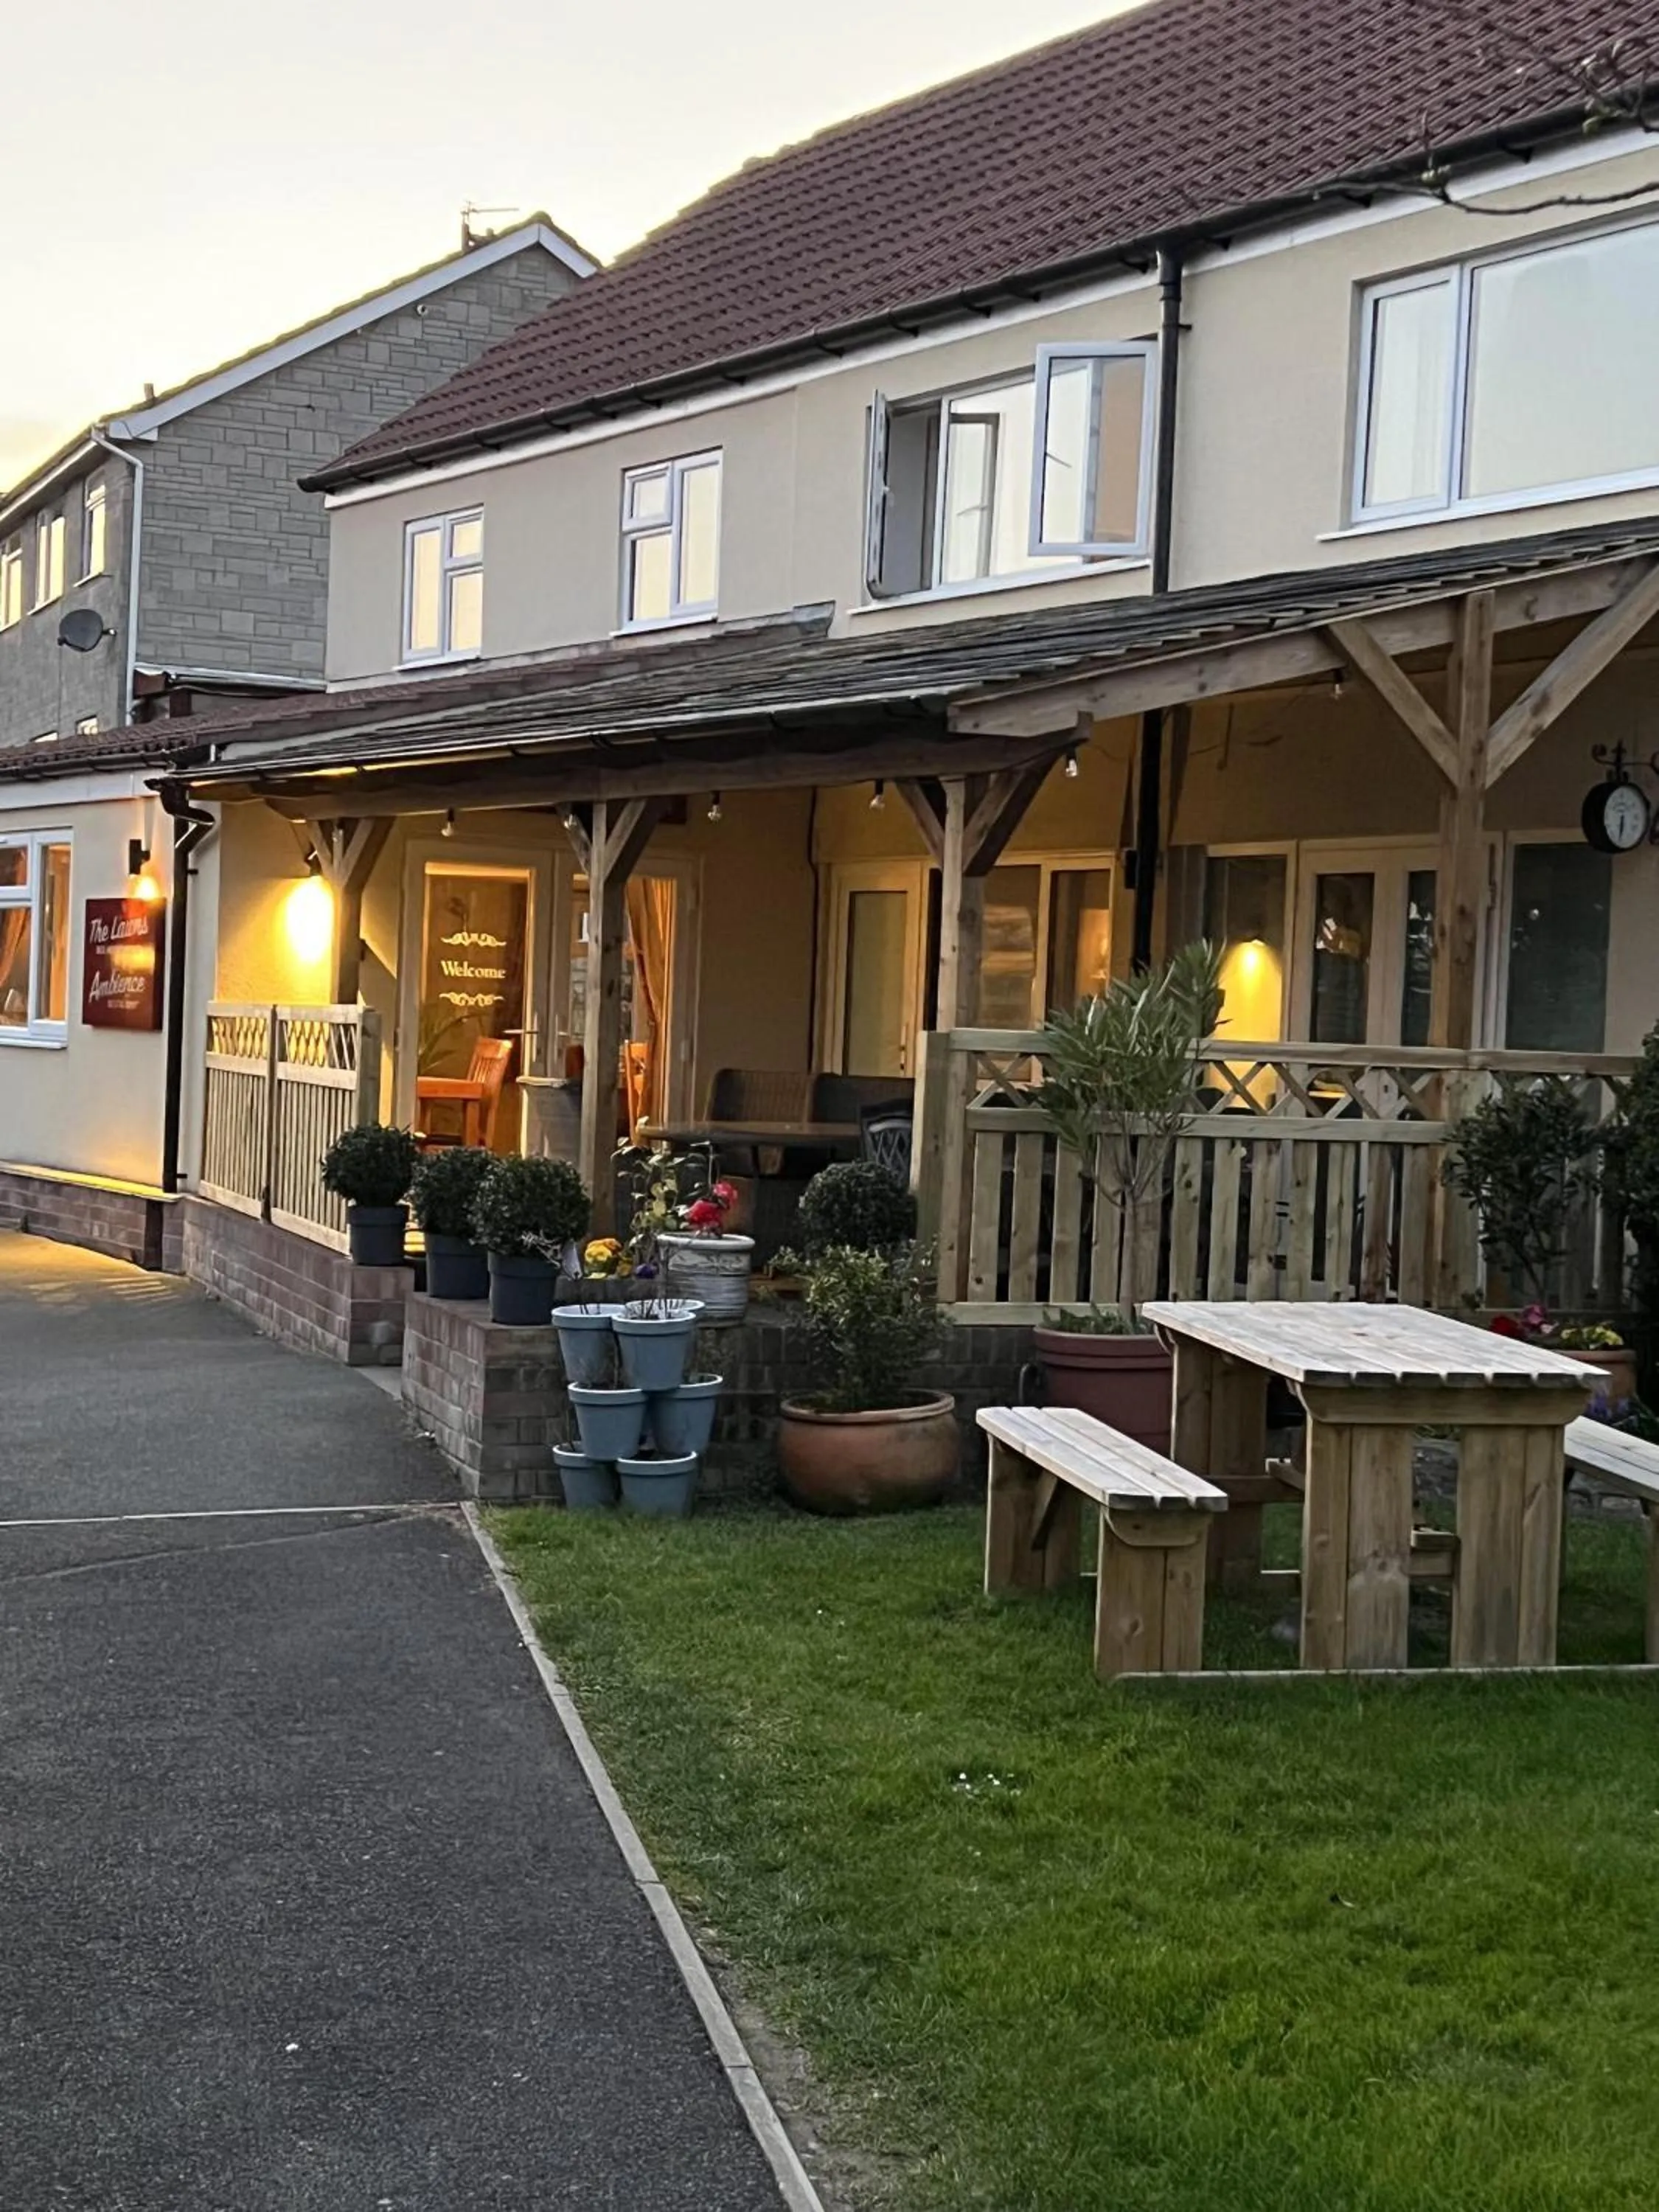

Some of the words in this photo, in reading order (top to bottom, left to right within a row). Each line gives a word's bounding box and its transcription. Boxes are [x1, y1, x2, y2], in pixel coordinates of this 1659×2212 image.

[89, 919, 109, 944] The
[441, 960, 507, 979] Welcome
[88, 969, 145, 1003] Ambience
